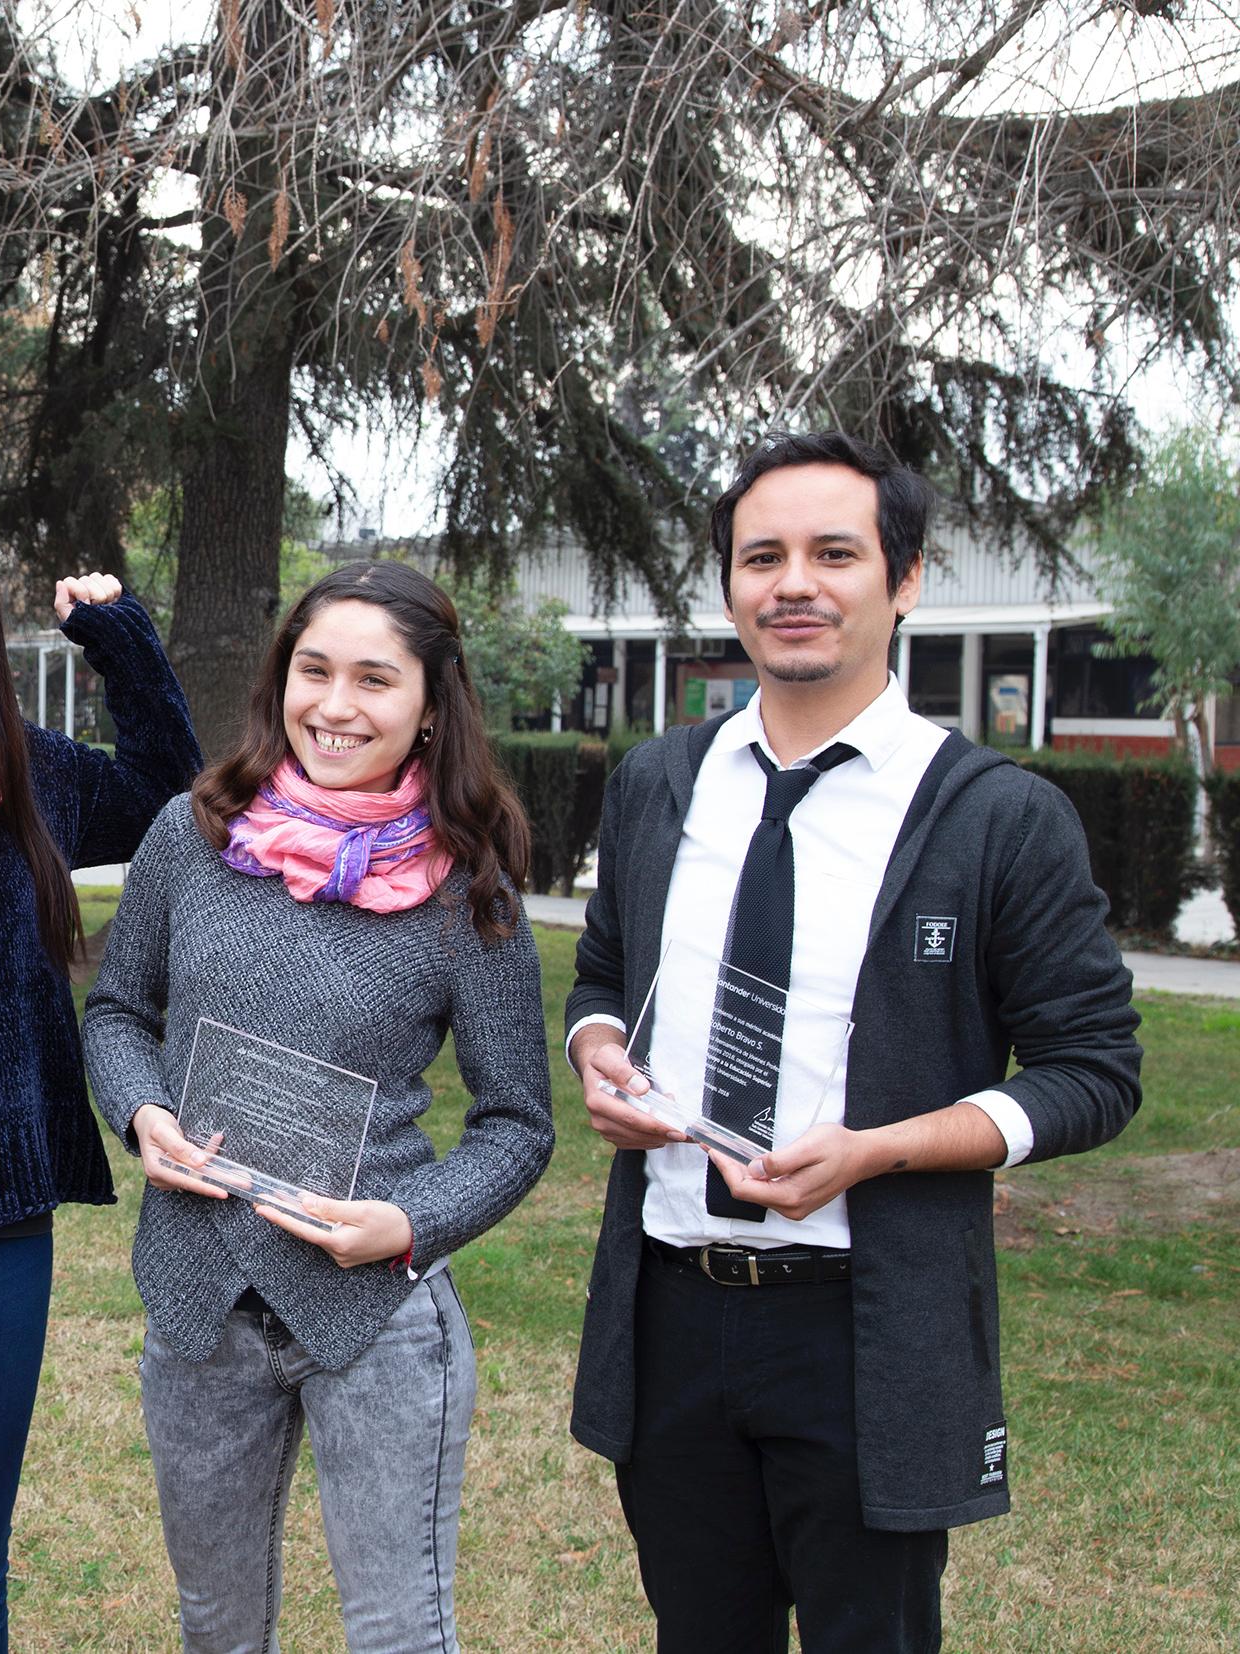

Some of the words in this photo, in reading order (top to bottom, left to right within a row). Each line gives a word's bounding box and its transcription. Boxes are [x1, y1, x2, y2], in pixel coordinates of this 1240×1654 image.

[744, 1021, 762, 1033] méritos
[734, 1031, 756, 1047] Bravo
[755, 1040, 765, 1050] S.
[727, 1063, 753, 1079] Educación
[751, 1074, 772, 1088] Superior
